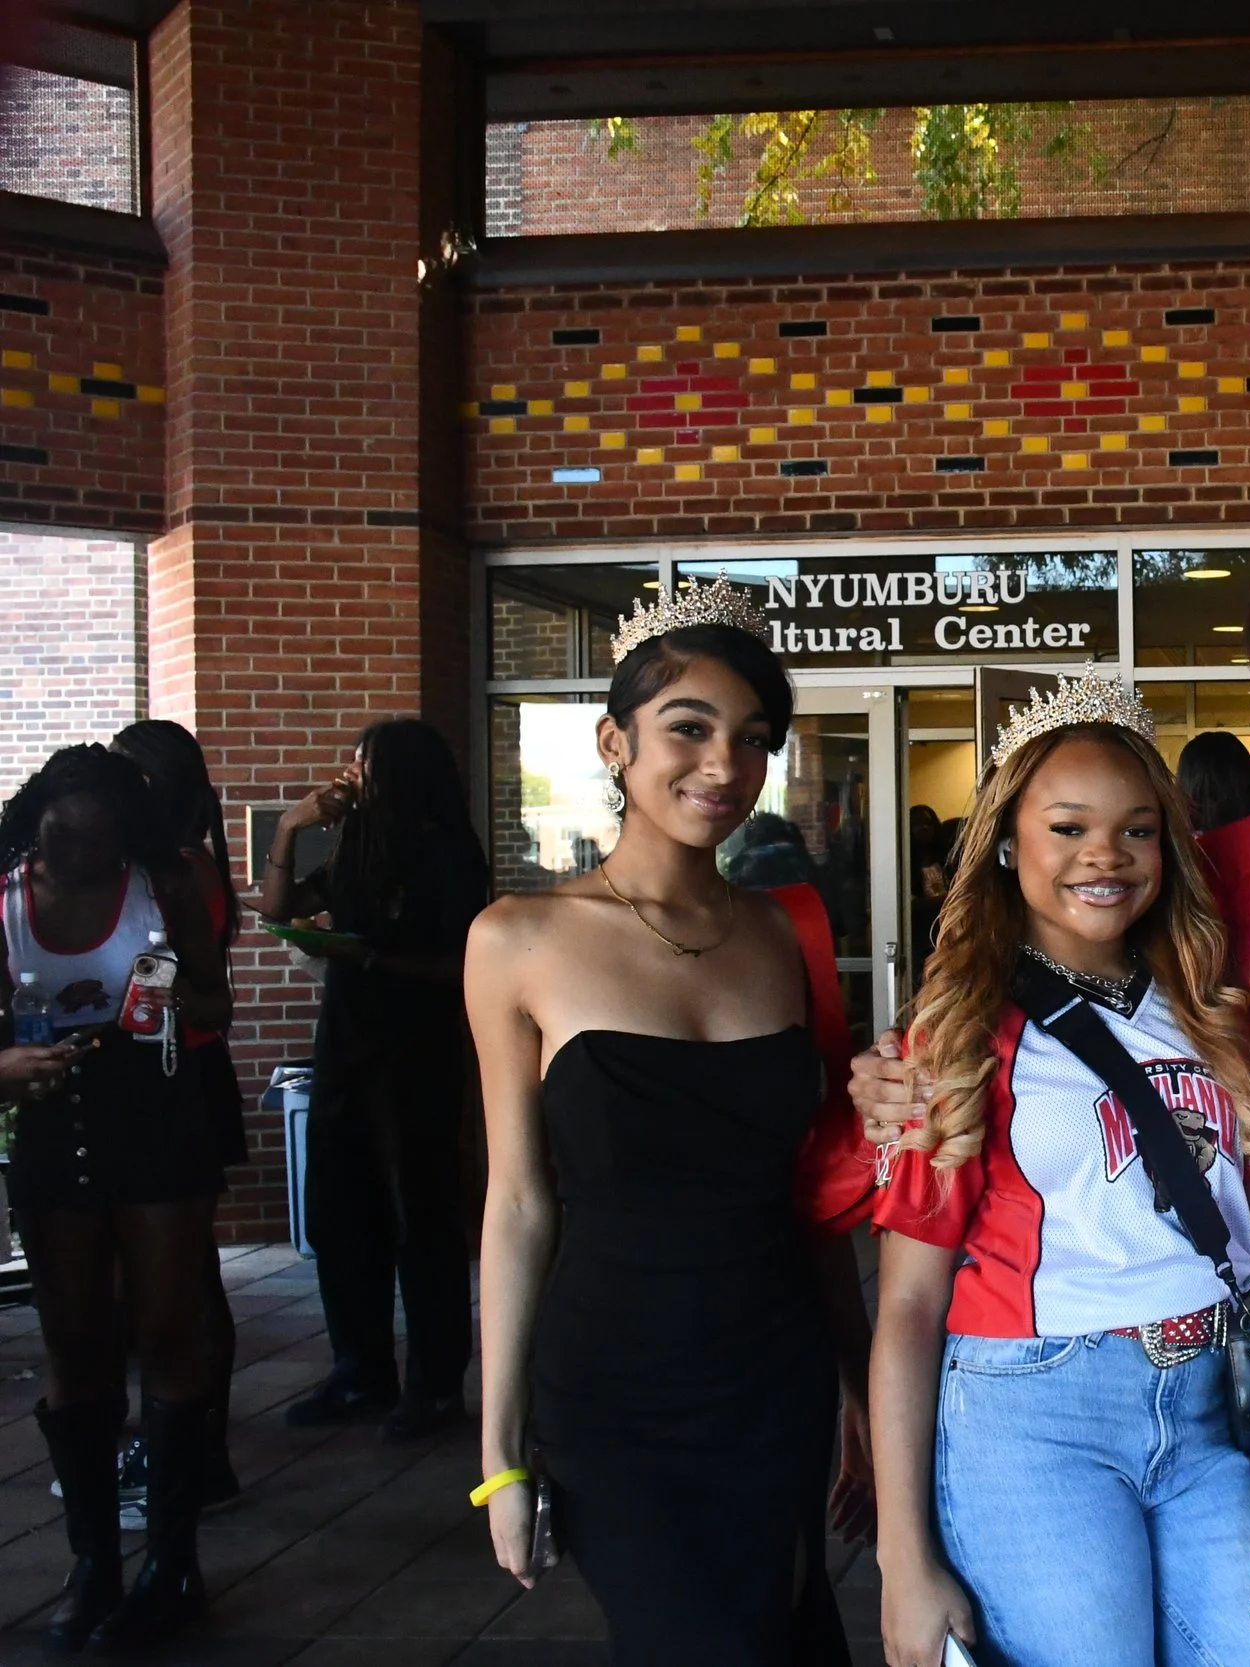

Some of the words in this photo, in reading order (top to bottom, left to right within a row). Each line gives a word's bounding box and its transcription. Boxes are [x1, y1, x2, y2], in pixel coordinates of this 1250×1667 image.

[765, 570, 1028, 608] NYUMBURU
[769, 618, 904, 653] ltural
[934, 616, 1091, 650] Center
